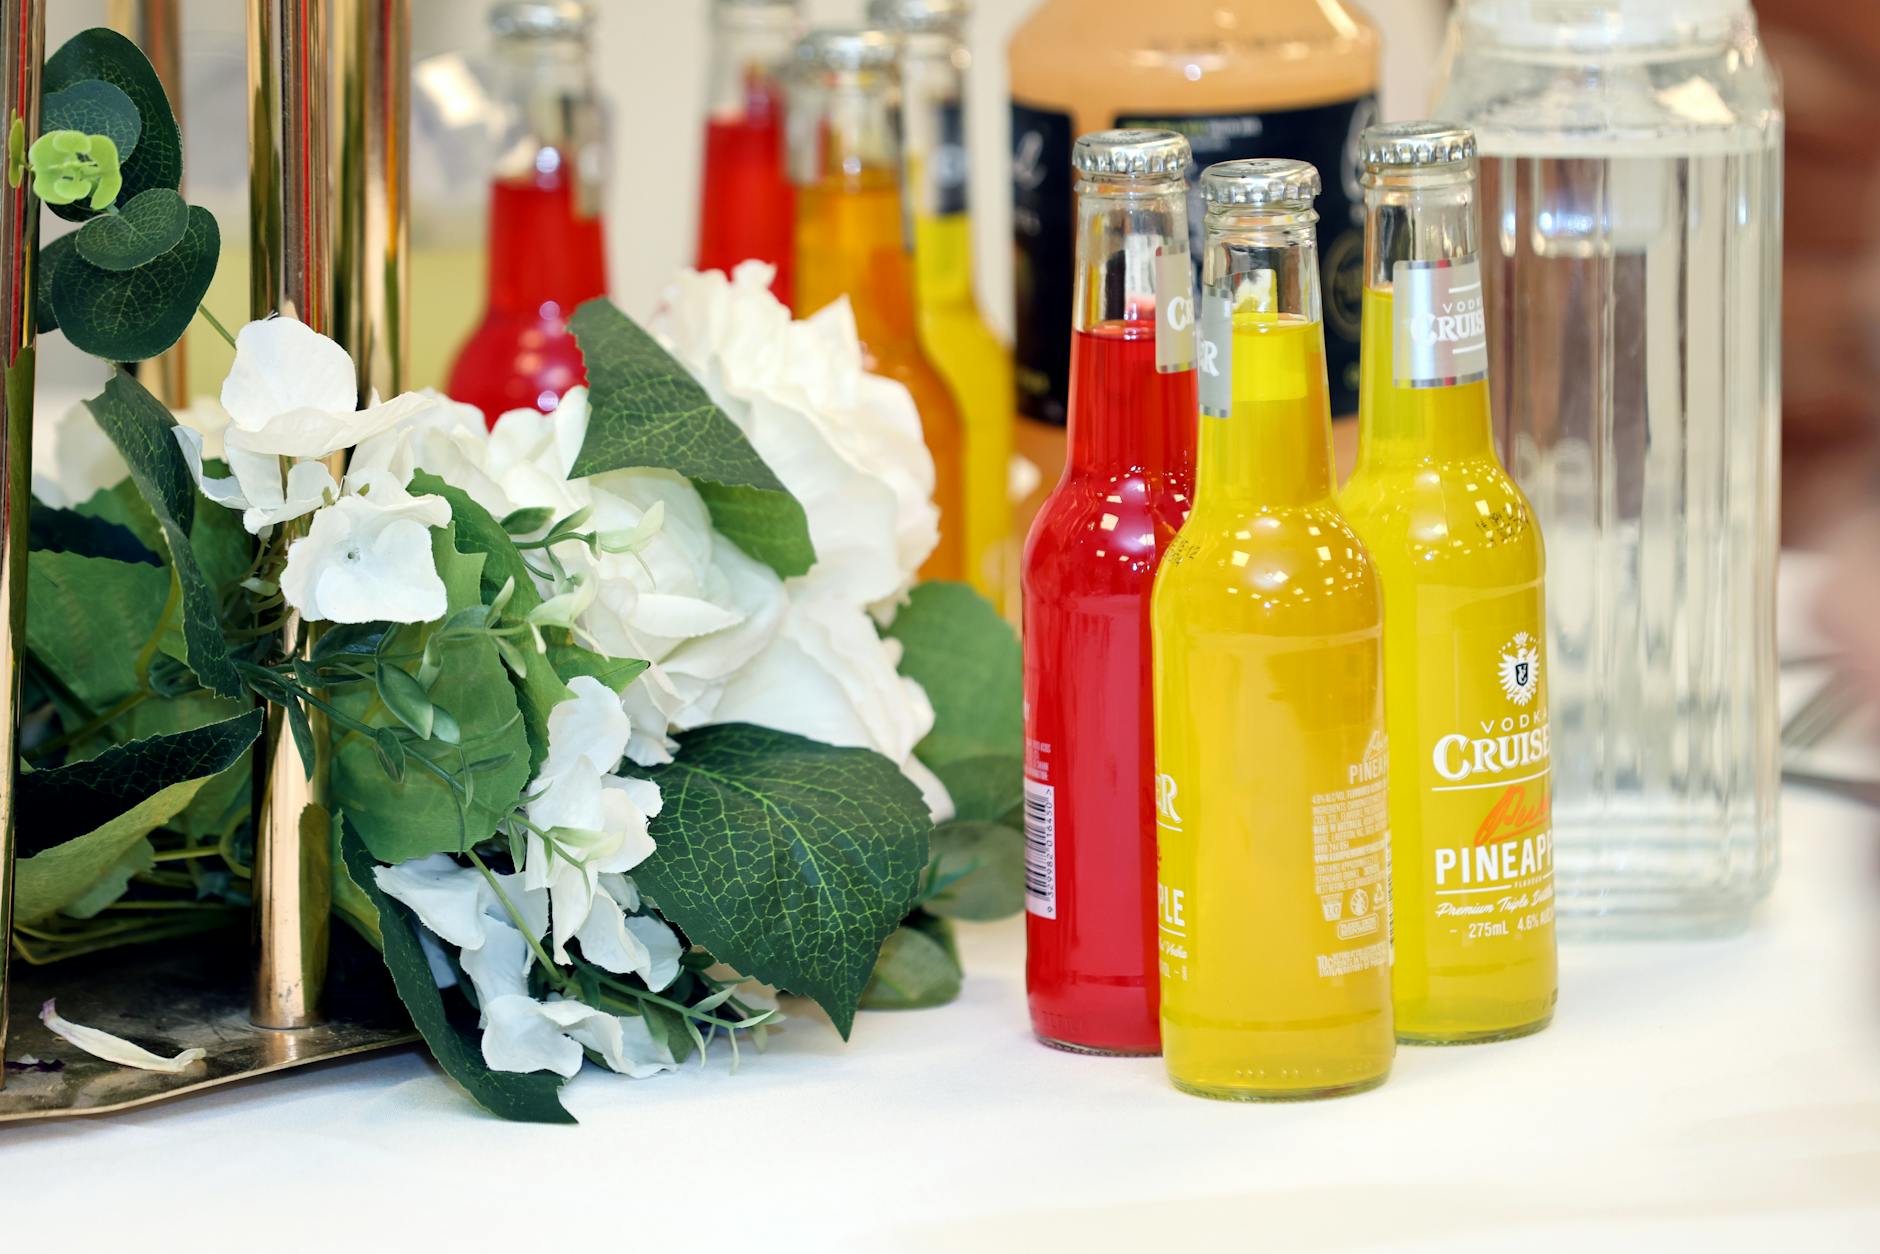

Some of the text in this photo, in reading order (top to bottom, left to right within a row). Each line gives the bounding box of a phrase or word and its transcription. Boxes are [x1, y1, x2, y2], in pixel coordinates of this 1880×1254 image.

[1199, 340, 1219, 377] R
[1435, 902, 1495, 917] Premium
[1468, 920, 1509, 939] 275mL
